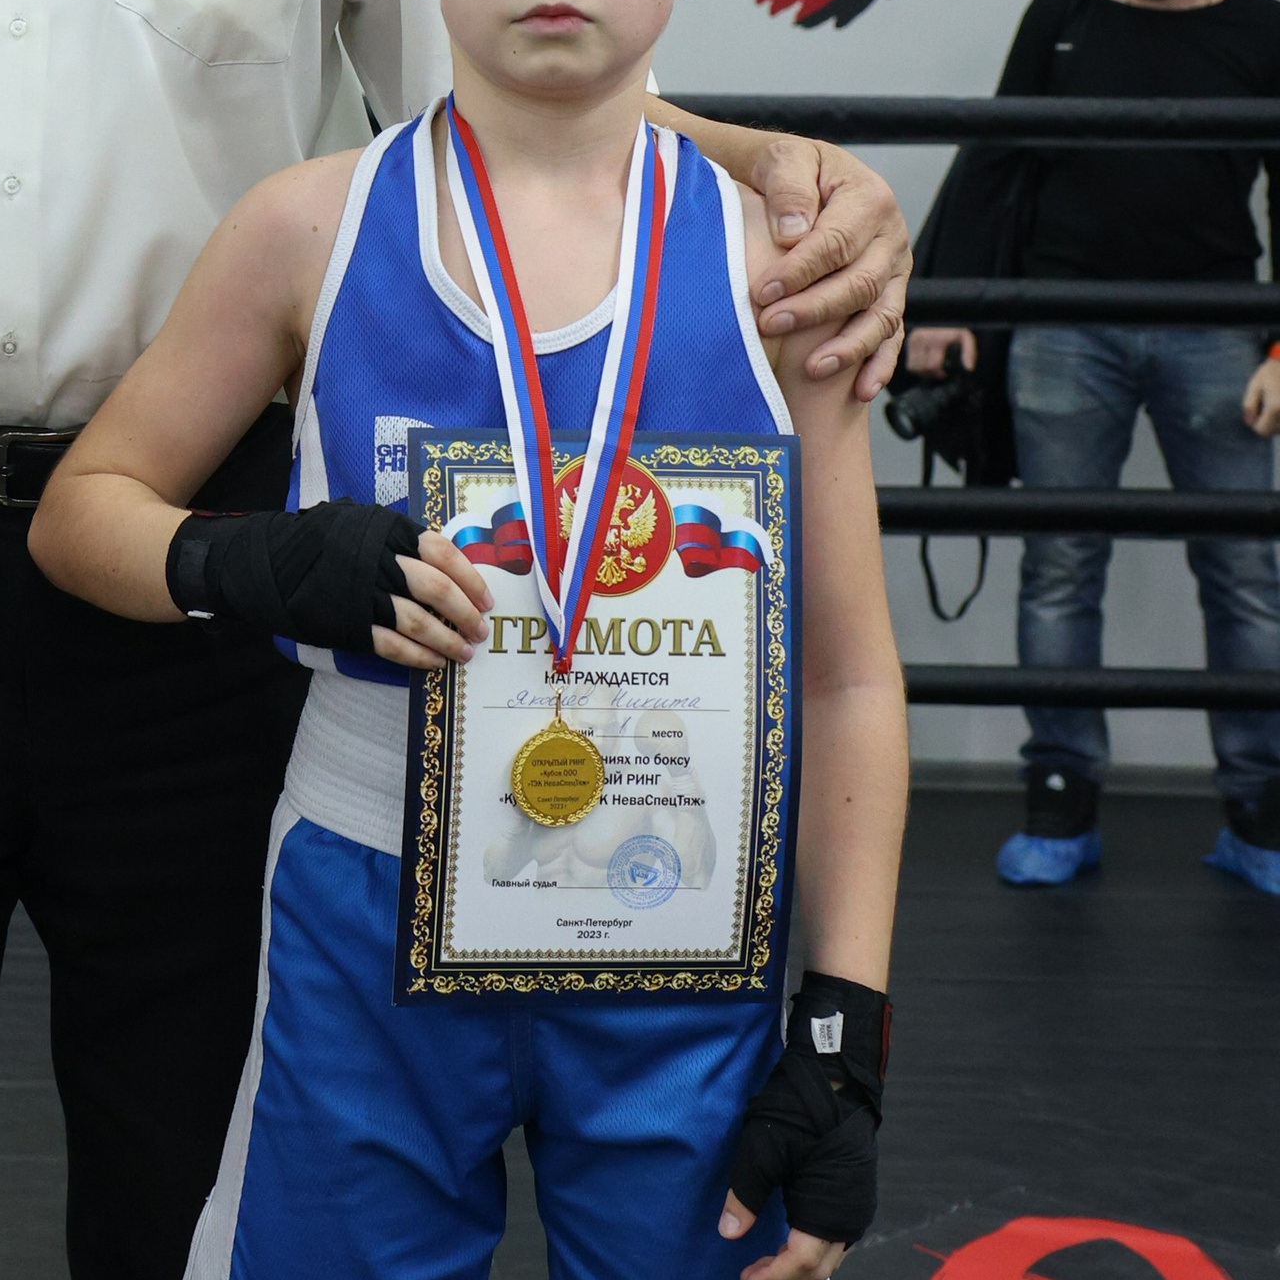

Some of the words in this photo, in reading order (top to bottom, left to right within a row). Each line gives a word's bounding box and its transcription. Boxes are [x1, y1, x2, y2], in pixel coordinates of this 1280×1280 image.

[544, 671, 669, 687] НАГРАЖДАЕТСЯ
[652, 730, 684, 738] место
[637, 756, 650, 765] по
[652, 753, 690, 768] боксу
[627, 775, 661, 785] РИНГ
[492, 879, 530, 888] Главный
[532, 880, 558, 889] судья
[556, 918, 633, 928] Санкт-Петербург
[577, 931, 602, 939] 2023
